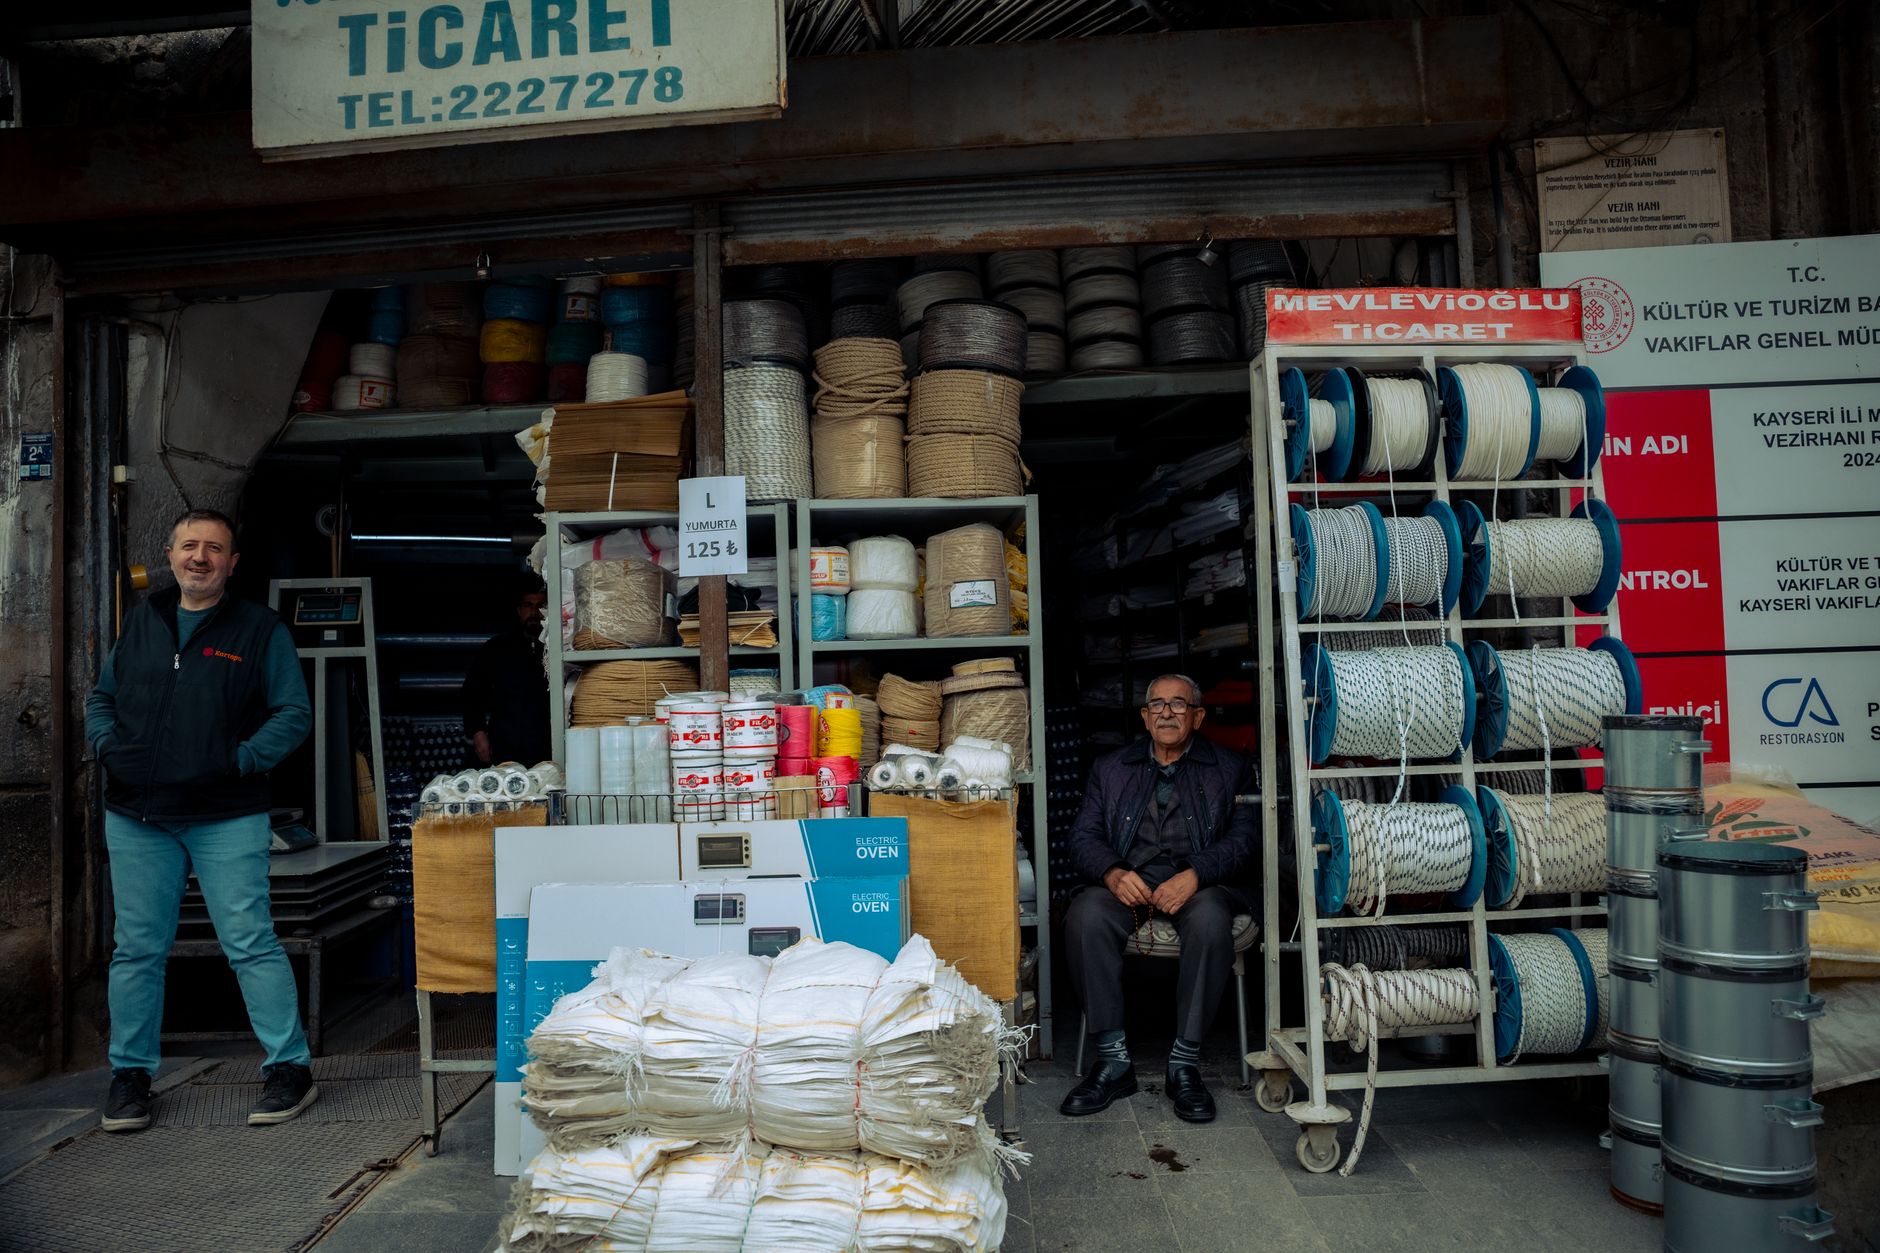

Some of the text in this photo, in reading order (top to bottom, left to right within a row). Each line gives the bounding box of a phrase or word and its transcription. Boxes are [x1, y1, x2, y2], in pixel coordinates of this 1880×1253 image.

[337, 65, 685, 130] TEL:2227278
[1634, 156, 1657, 166] HANI
[1607, 201, 1660, 213] VEZİR HANI
[1623, 216, 1629, 225] by
[1645, 223, 1658, 231] three
[1673, 222, 1682, 230] and
[1786, 265, 1826, 283] T.C.
[1643, 300, 1729, 321] KÜLTÜR
[1734, 301, 1763, 317] VE
[1769, 295, 1851, 317] TURİZM
[1644, 334, 1751, 353] VAKIFLAR
[1758, 330, 1832, 349] GENEL
[1753, 407, 1835, 427] KAYSERİ
[1841, 406, 1862, 424] İLİ
[1640, 434, 1688, 455] ADI
[1763, 430, 1865, 448] VEZİRHANI
[706, 492, 716, 509] L
[685, 519, 737, 531] YUMURTA
[687, 541, 721, 559] 125
[1776, 556, 1842, 572] KÜLTÜR
[1847, 557, 1869, 570] VE
[1777, 577, 1860, 591] VAKIFLAR
[1740, 595, 1811, 612] KAYSERİ
[1760, 732, 1845, 745] RESTORASYON
[856, 836, 898, 845] ELECTRIC
[856, 846, 899, 859] OVEN
[852, 892, 890, 900] ELECTRIC
[852, 901, 890, 913] OVEN
